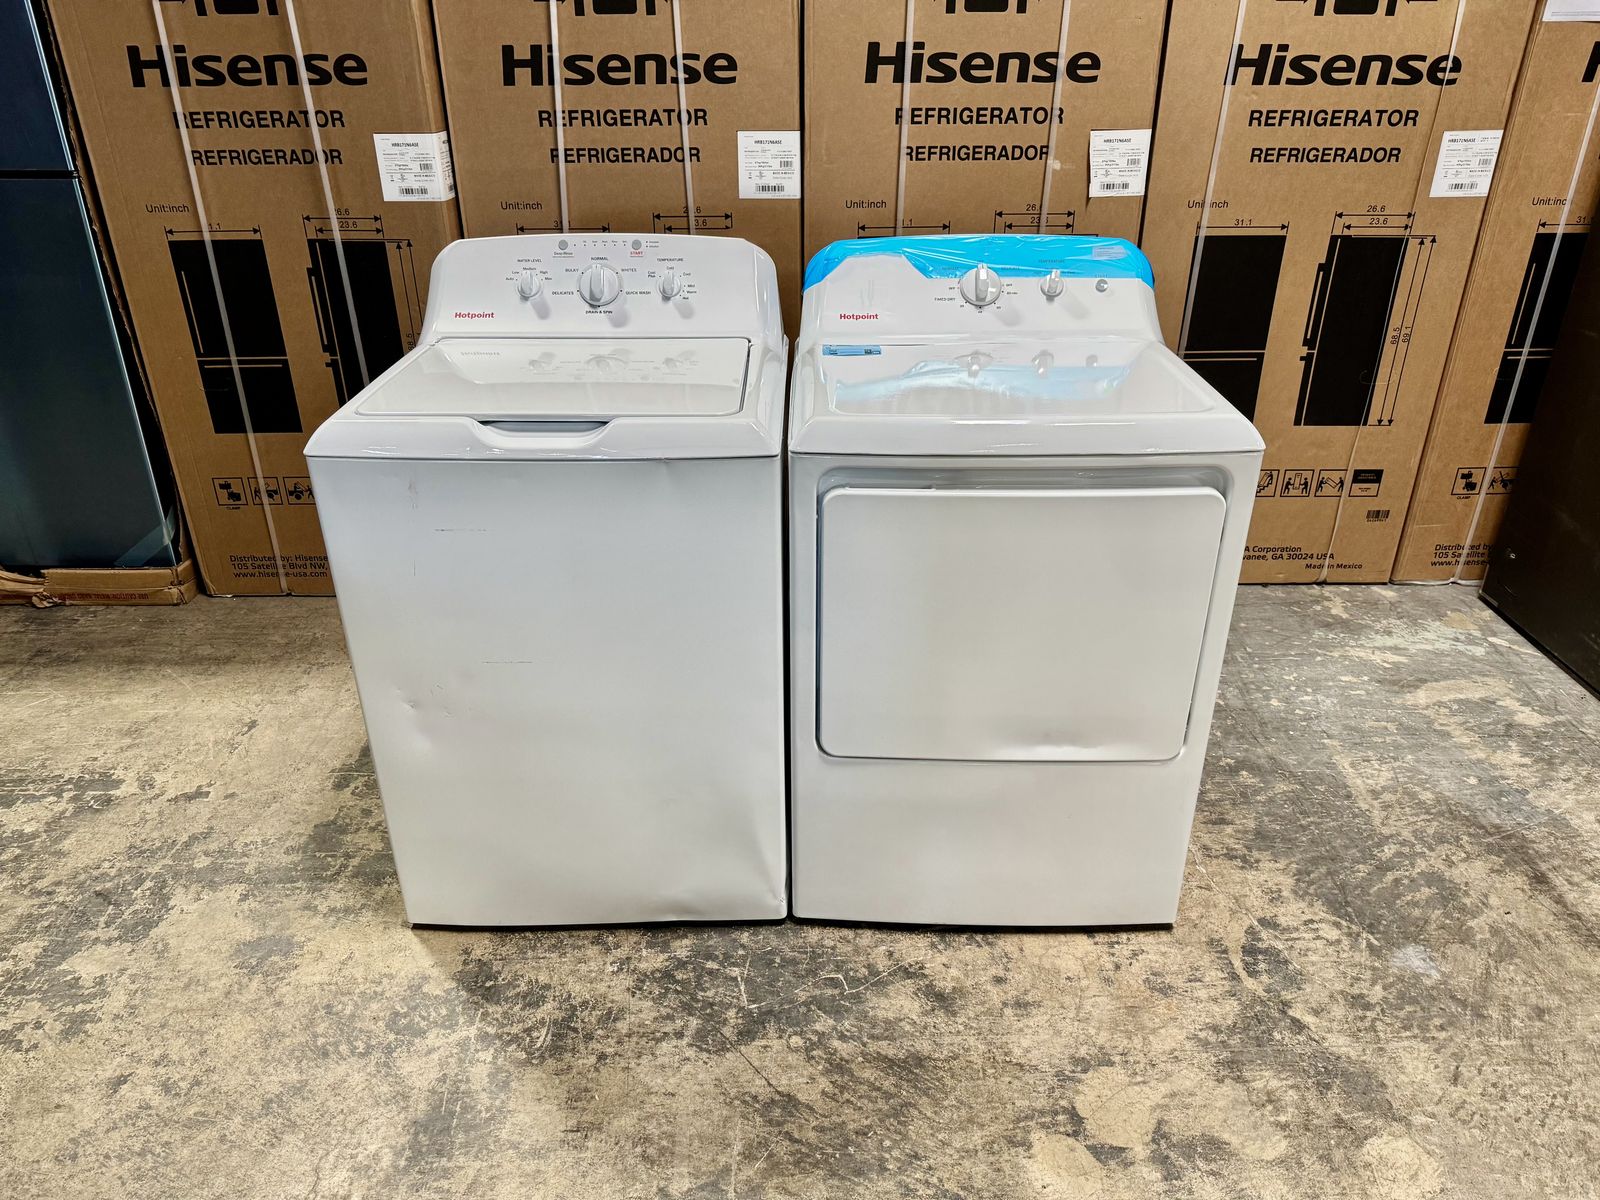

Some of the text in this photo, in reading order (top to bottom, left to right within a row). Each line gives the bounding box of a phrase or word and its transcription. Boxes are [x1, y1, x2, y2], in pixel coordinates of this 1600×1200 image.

[126, 45, 368, 88] Hisense
[501, 45, 738, 87] Hisense
[864, 41, 1101, 84] Hisense
[1223, 43, 1462, 86] Hisense
[538, 108, 708, 128] REFRIGERATOR
[1248, 109, 1419, 127] REFRIGERATOR
[191, 148, 344, 166] REFRIGERADOR
[1249, 147, 1401, 163] REFRIGERADOR
[500, 201, 543, 210] Unit:inch
[845, 199, 887, 209] Unit:inch
[1531, 197, 1567, 206] Unit:inc
[145, 203, 190, 214] Unit:inch
[334, 207, 350, 216] 6.6
[682, 206, 702, 214] 2.6
[1026, 203, 1042, 212] 26.
[1366, 204, 1386, 213] 26.6
[339, 221, 358, 229] 23.6
[1234, 218, 1253, 226] 31.1
[1369, 217, 1388, 225] 23.6
[454, 311, 495, 320] Hotpoint
[839, 313, 879, 321] Hotpoint
[1390, 327, 1400, 345] 68.5
[1401, 325, 1412, 343] 69.1
[1252, 546, 1302, 554] Corporation
[1433, 551, 1449, 559] 105
[232, 562, 249, 570] 105
[289, 562, 308, 570] Blvd
[310, 562, 328, 570] NW,
